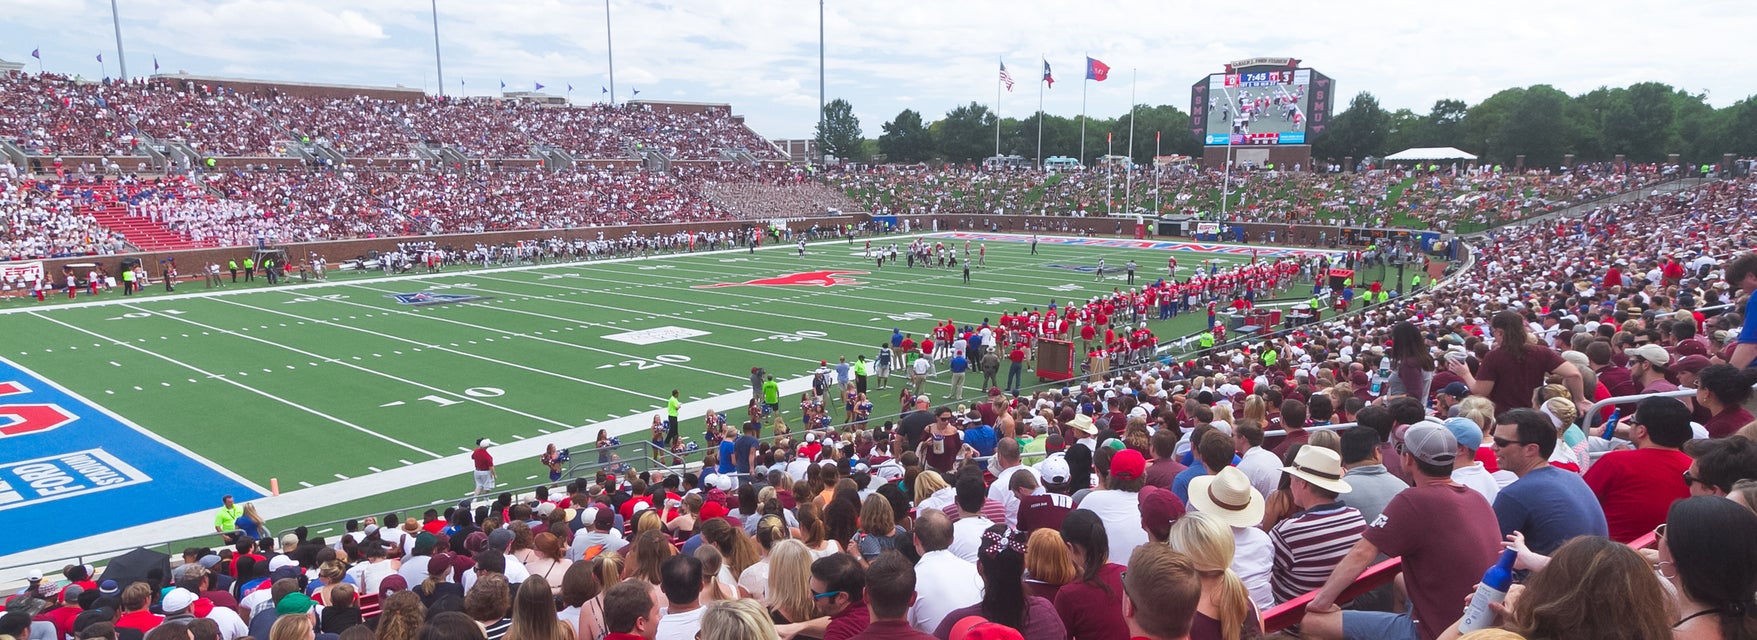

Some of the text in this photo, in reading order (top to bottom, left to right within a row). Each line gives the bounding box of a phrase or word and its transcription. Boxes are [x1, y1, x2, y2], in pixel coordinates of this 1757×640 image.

[1247, 73, 1266, 81] 7:45
[1193, 96, 1203, 125] SMU
[1314, 91, 1325, 121] SMU
[5, 265, 39, 276] ESPN
[887, 312, 933, 321] 40
[769, 331, 828, 342] 30
[619, 354, 691, 370] 20
[418, 387, 505, 406] 10
[60, 454, 125, 486] STADIUM
[12, 463, 86, 496] FORD
